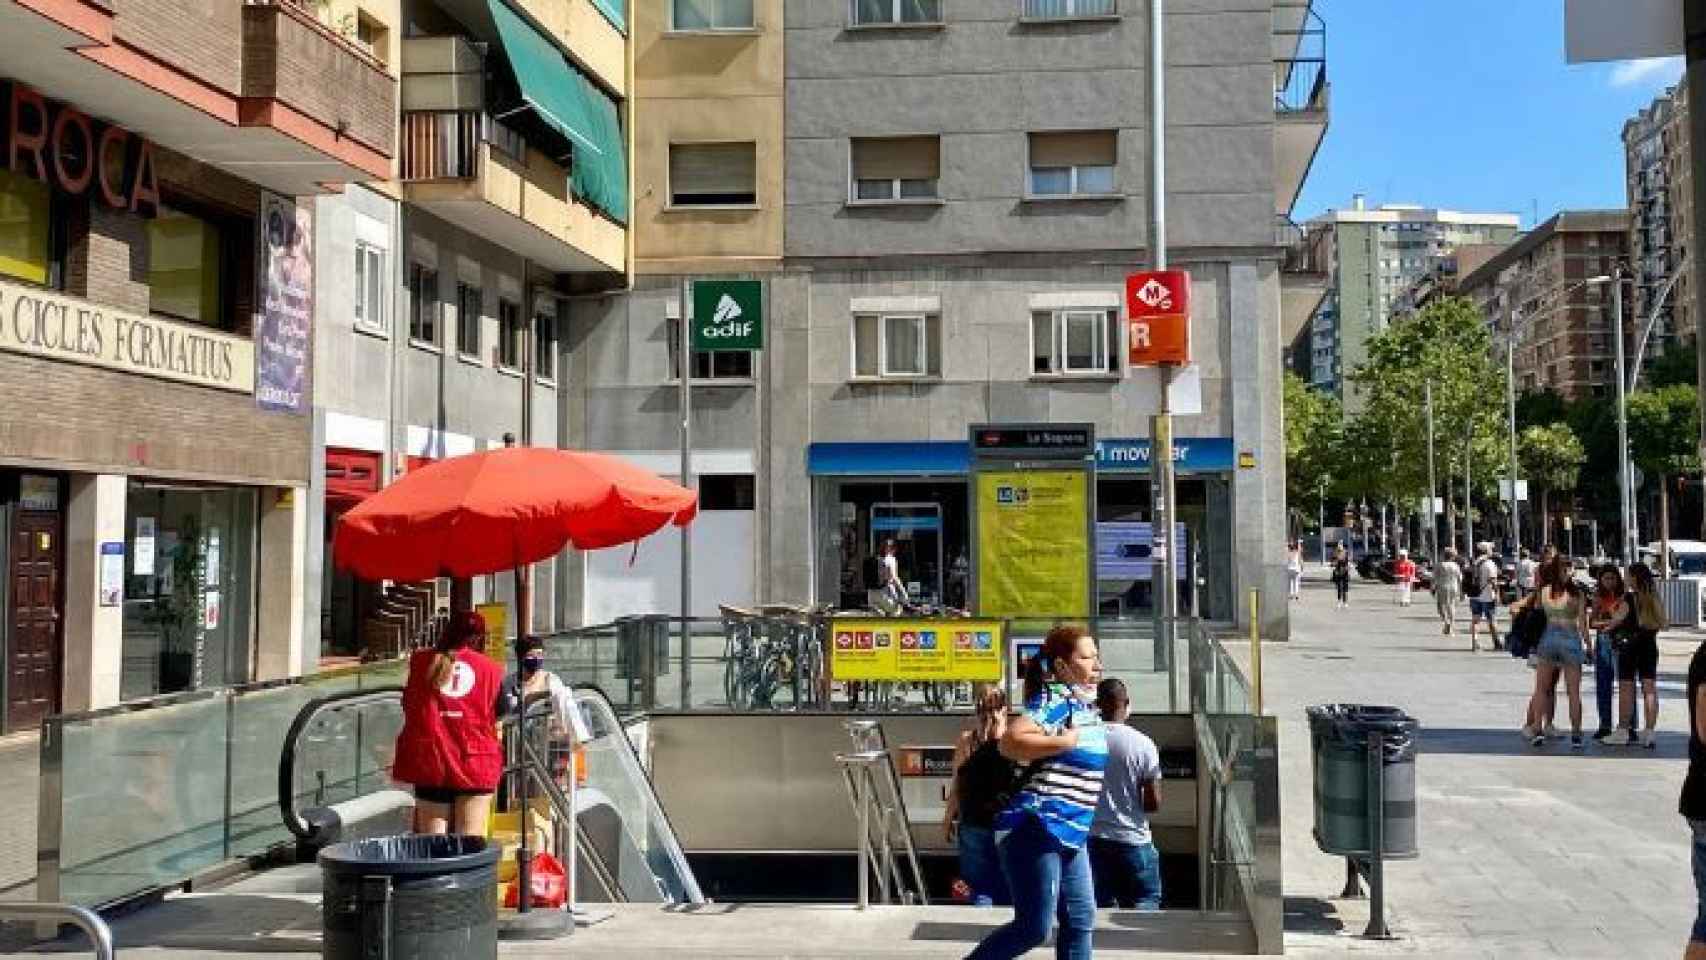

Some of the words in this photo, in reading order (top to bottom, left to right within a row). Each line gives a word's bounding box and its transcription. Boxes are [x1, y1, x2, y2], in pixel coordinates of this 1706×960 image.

[10, 81, 161, 218] ROCA
[15, 295, 103, 355] CICLES
[703, 320, 754, 338] adif
[1131, 322, 1151, 349] R
[1111, 446, 1190, 461] movar
